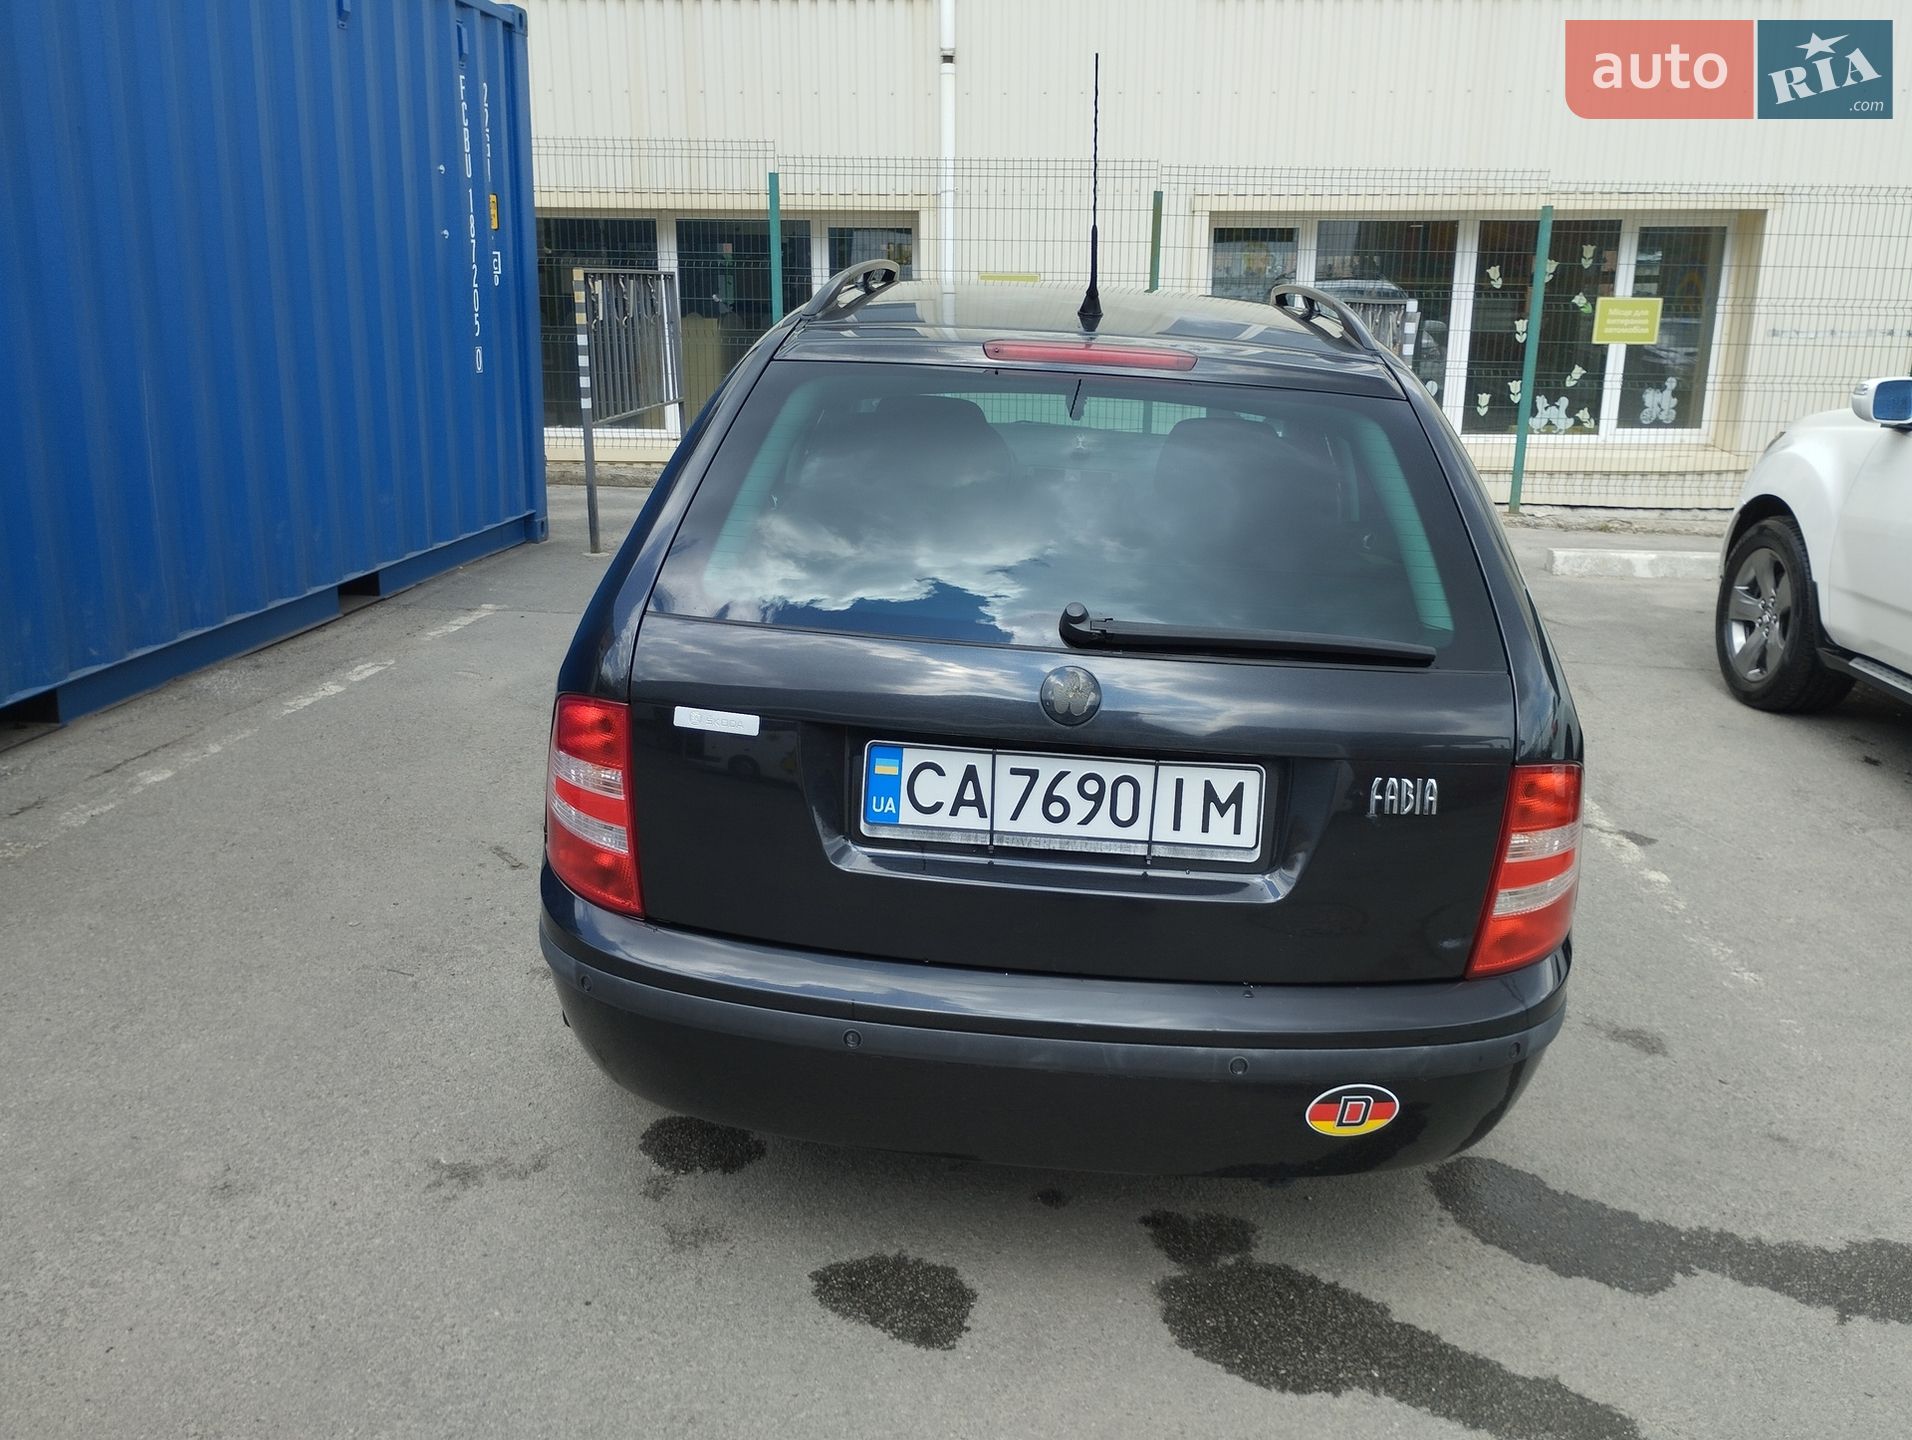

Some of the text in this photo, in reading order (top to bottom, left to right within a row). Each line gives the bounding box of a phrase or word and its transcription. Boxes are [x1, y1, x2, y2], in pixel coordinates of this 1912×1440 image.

[872, 795, 896, 814] UA
[906, 761, 1245, 835] CA 7690 IM
[1369, 777, 1438, 815] FABIA
[1336, 1095, 1374, 1128] D
